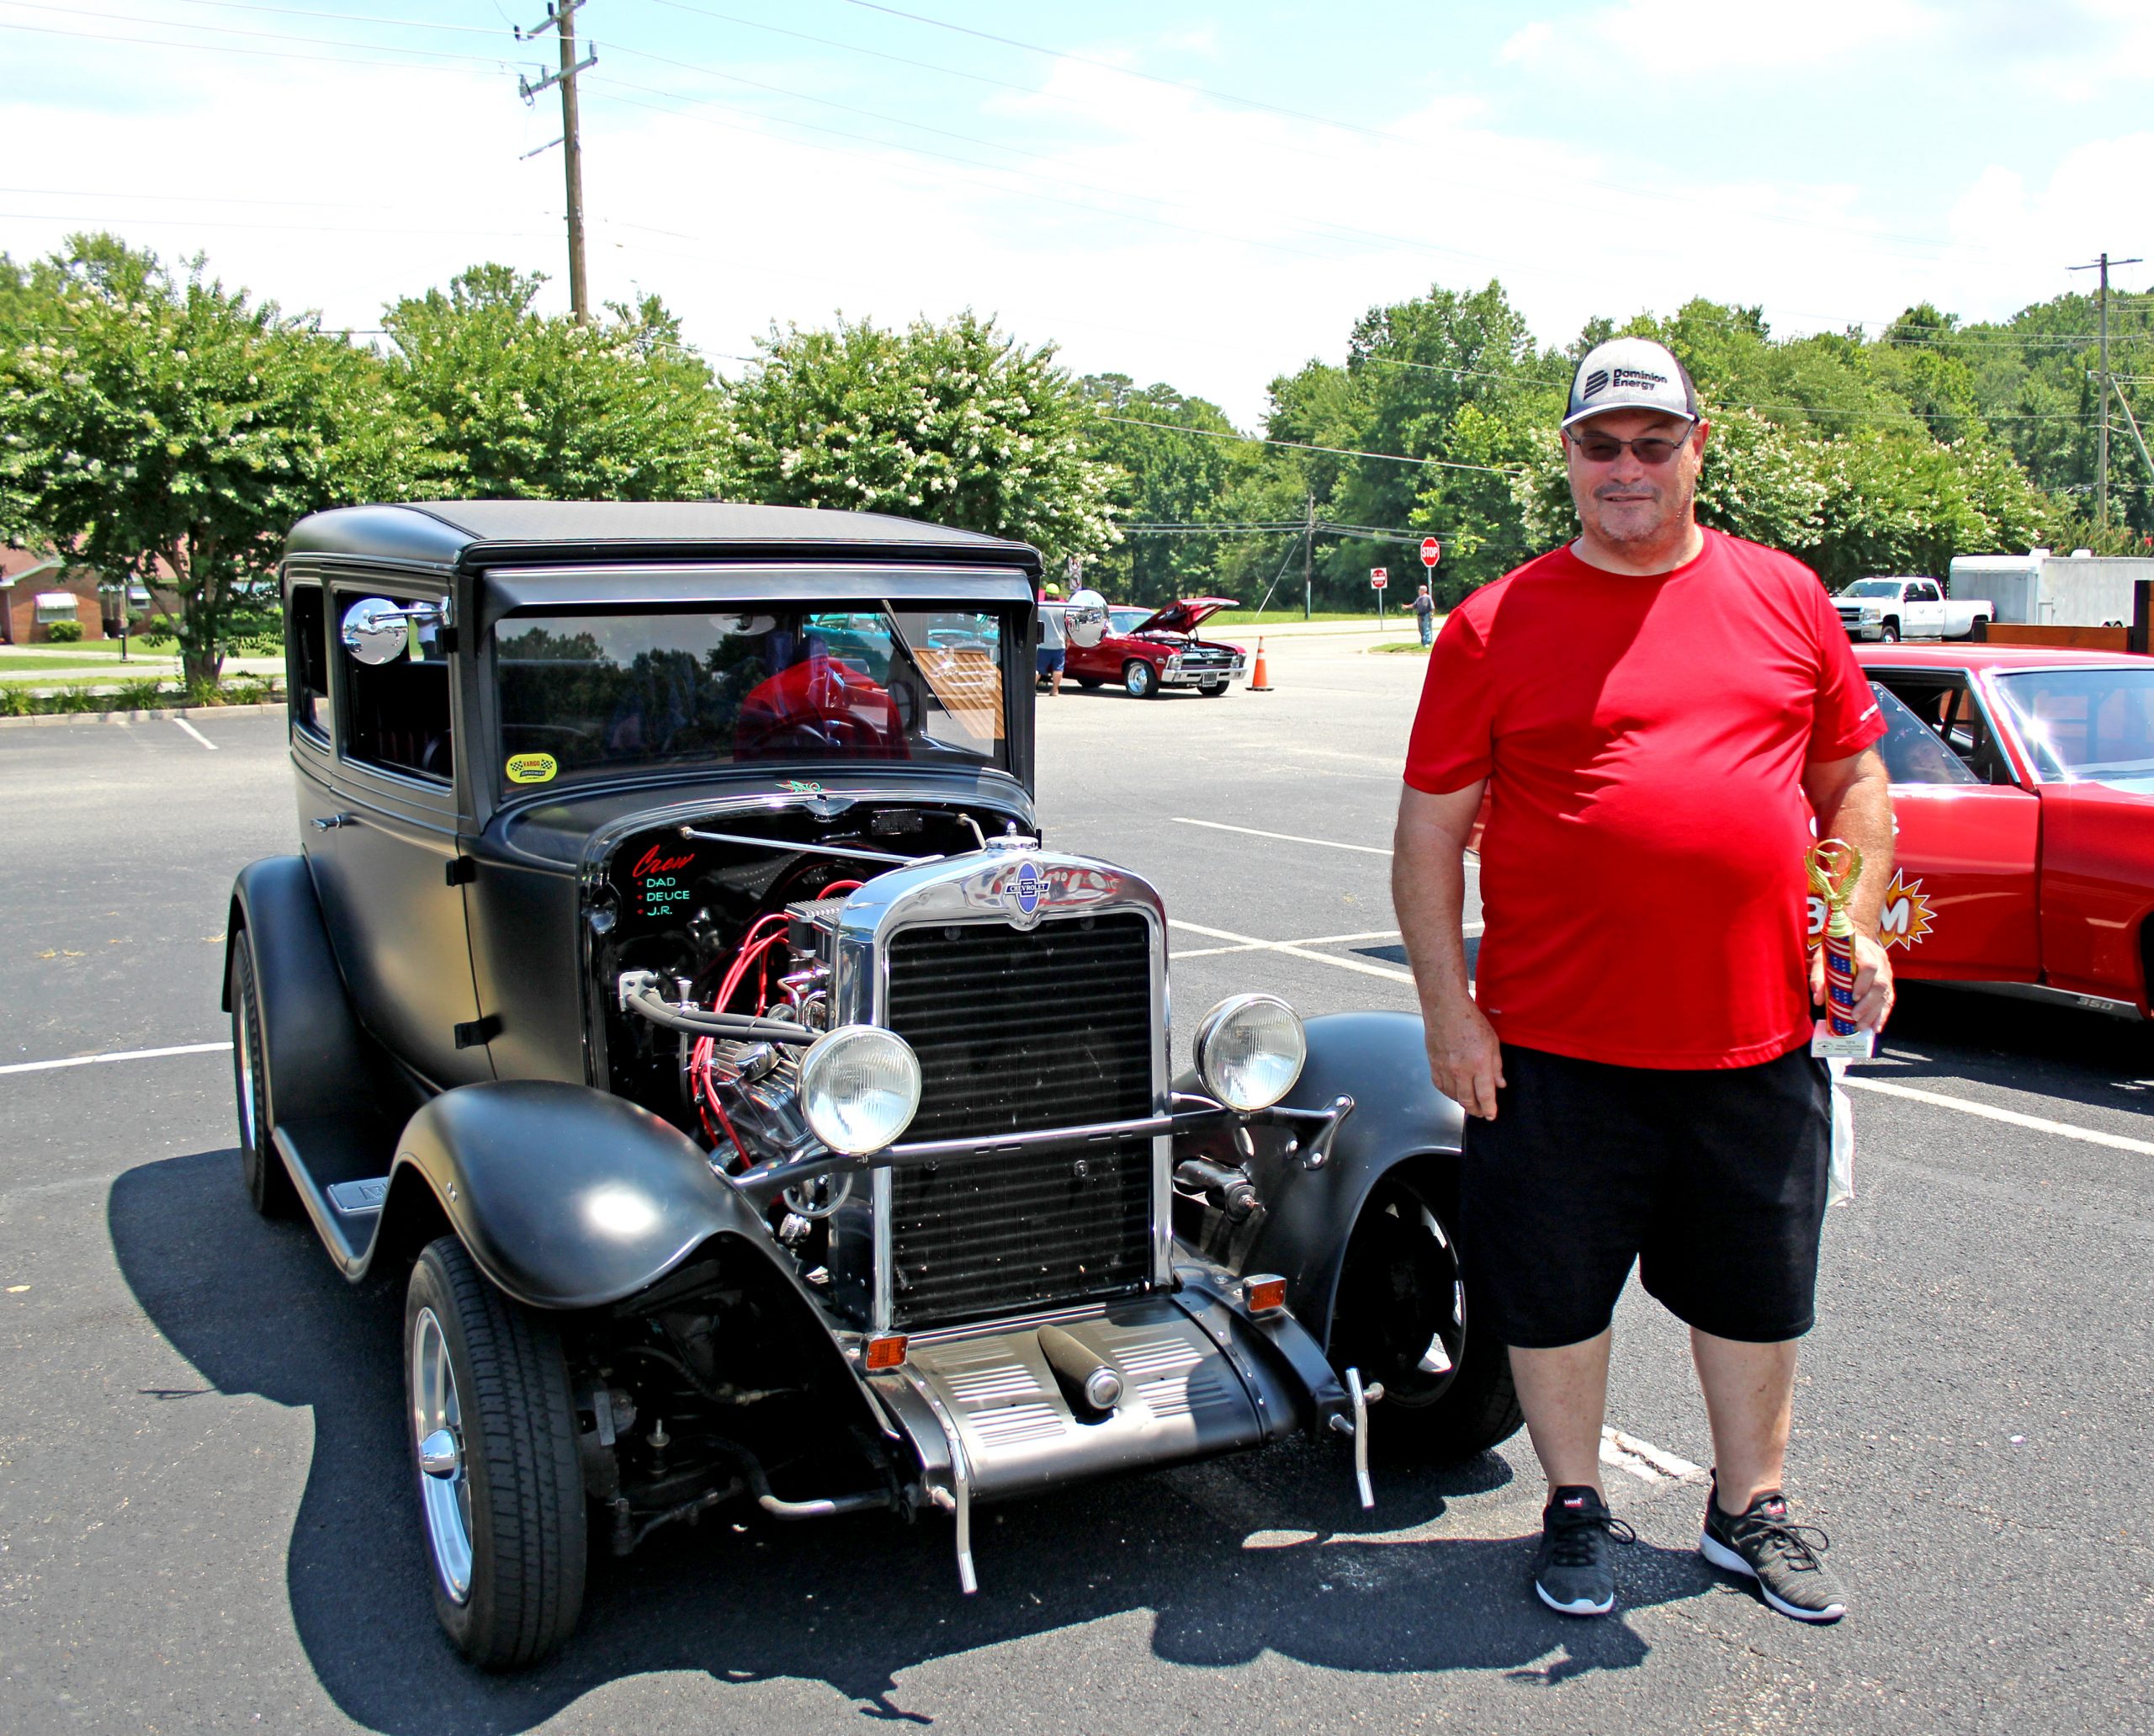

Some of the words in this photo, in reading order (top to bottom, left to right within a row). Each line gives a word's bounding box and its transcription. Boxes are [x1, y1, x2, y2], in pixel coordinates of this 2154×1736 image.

[1613, 369, 1668, 384] Dominion
[1613, 378, 1655, 390] Energy
[1422, 547, 1438, 558] STOP
[632, 844, 696, 878] Crew
[646, 877, 676, 889] DAD
[1010, 884, 1046, 892] CHEVROLET
[646, 890, 690, 902] DEUCE
[647, 905, 672, 916] J.R.
[2077, 996, 2114, 1011] 350
